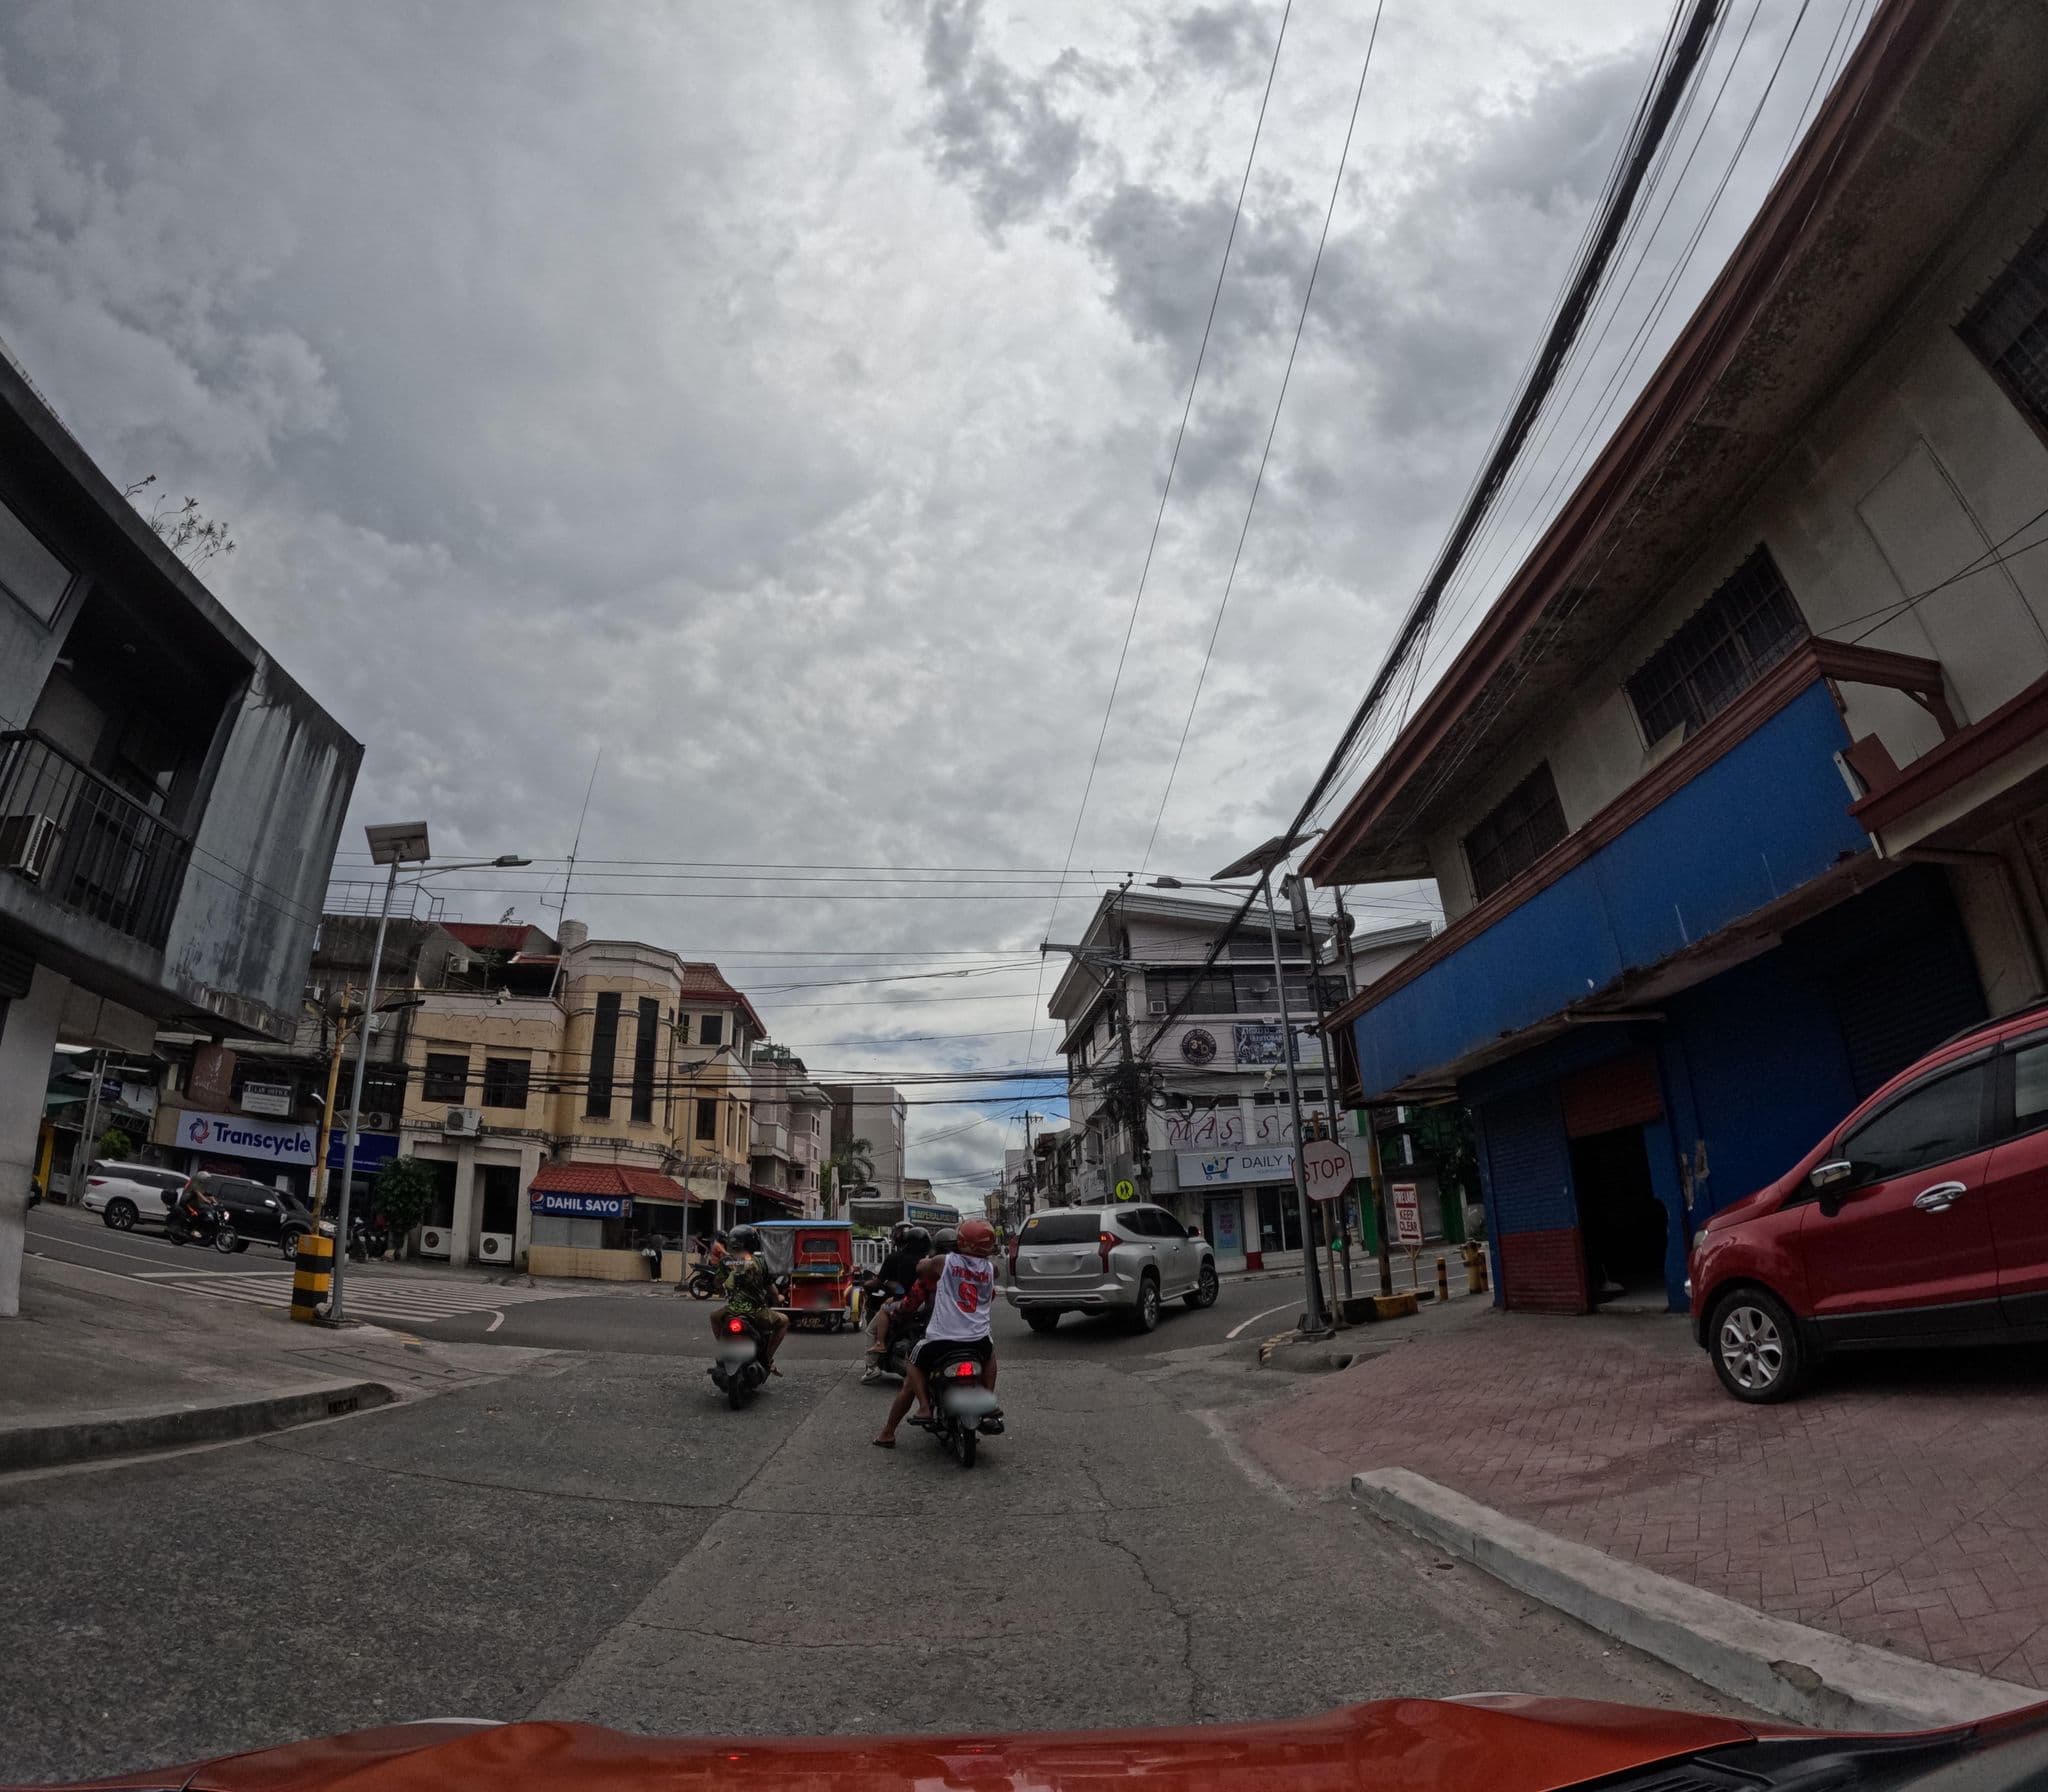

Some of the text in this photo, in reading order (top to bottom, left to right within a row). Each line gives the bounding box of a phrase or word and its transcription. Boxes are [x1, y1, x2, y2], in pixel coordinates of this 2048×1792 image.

[213, 1122, 311, 1156] Transcycle
[1242, 1155, 1283, 1169] DAILY
[1303, 1157, 1345, 1184] STOP
[546, 1196, 619, 1212] DAHIL SAYO
[1400, 1210, 1414, 1220] KEEP
[1400, 1221, 1417, 1232] CLEAR
[957, 1281, 977, 1313] 9
